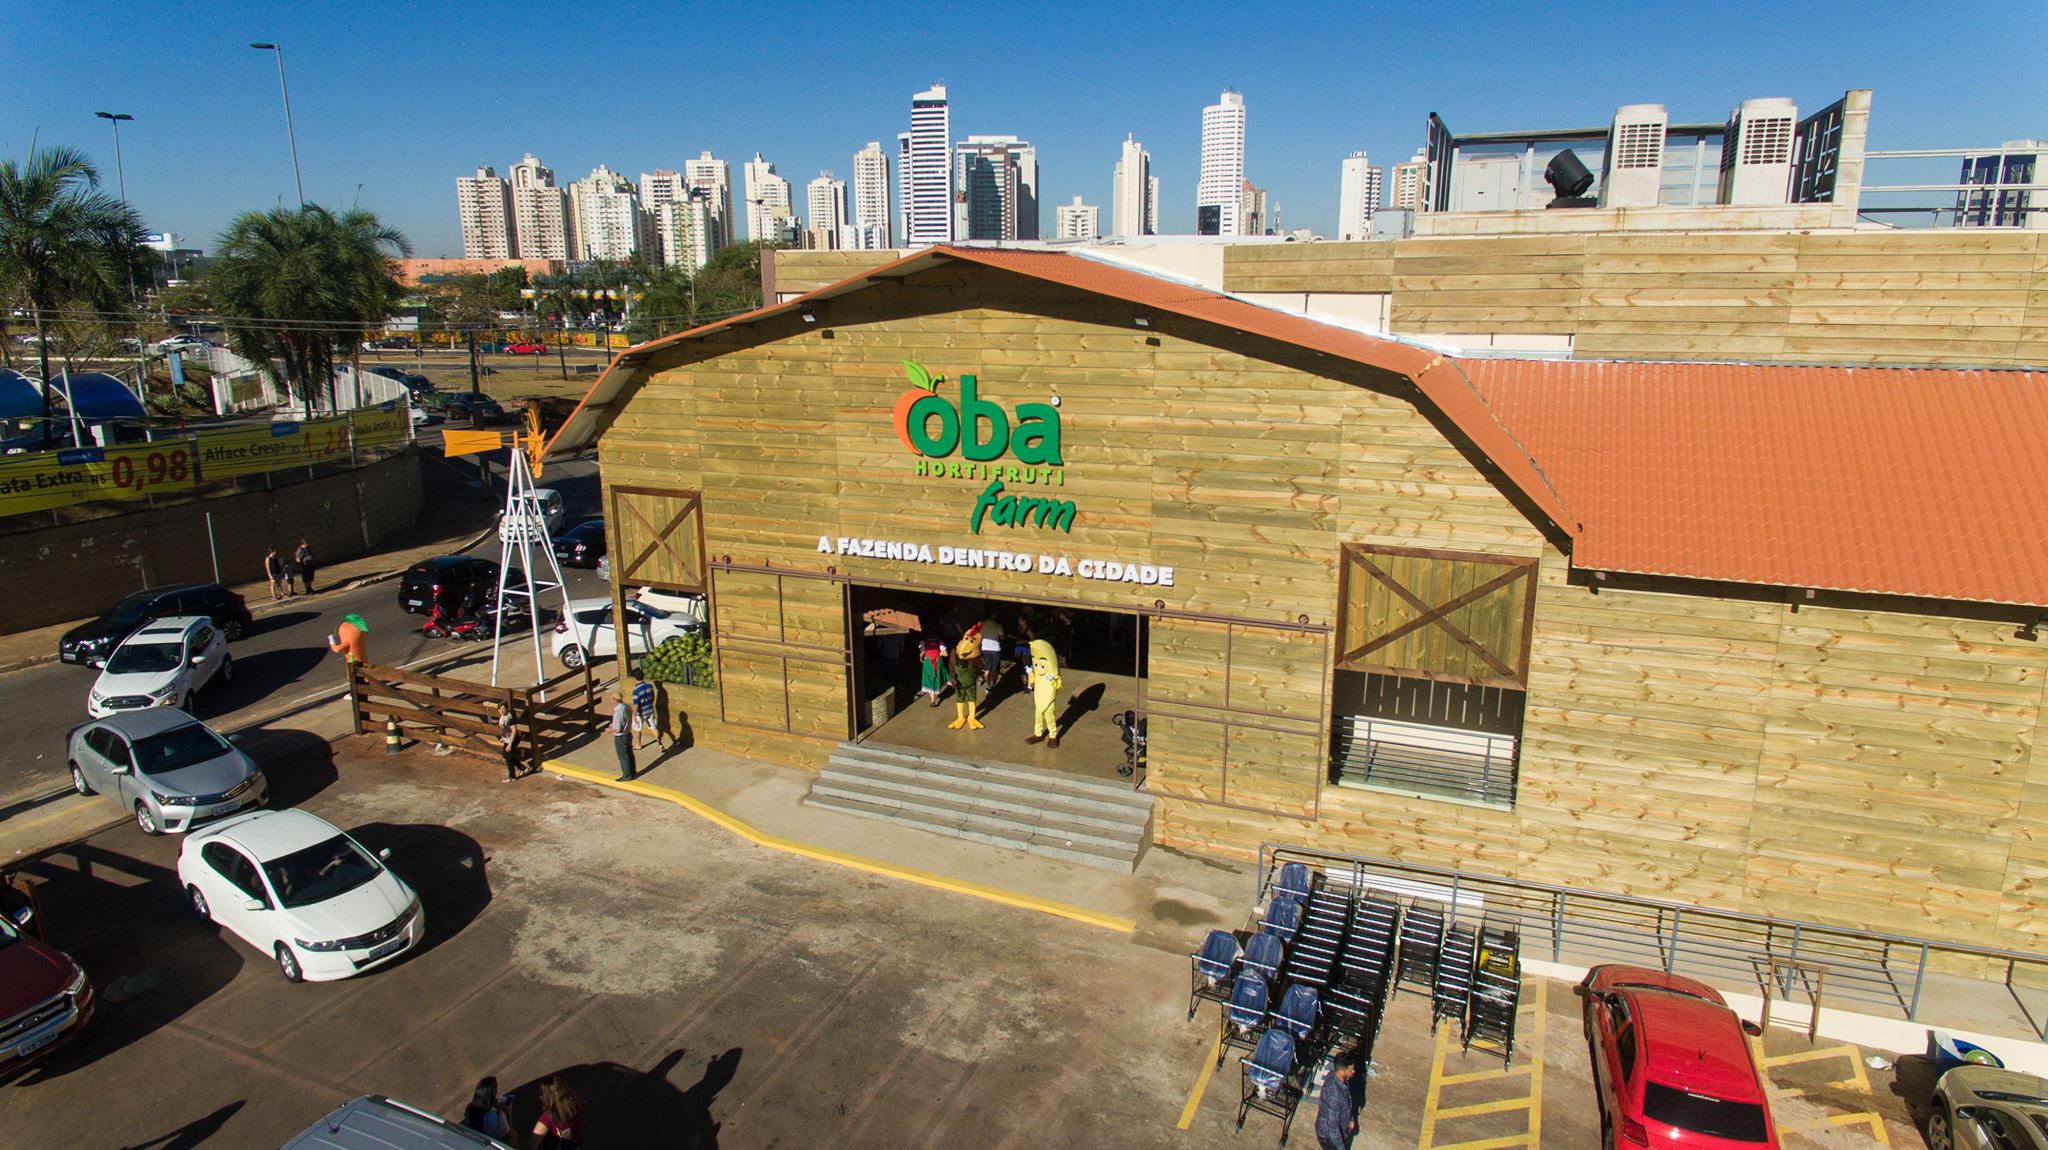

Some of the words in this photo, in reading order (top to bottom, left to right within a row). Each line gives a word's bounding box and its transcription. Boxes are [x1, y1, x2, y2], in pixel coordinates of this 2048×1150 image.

[907, 375, 1064, 466] oba
[36, 470, 82, 488] Extra
[91, 474, 106, 485] R$
[112, 449, 188, 491] 0,98
[205, 446, 247, 461] Alface
[915, 461, 1064, 486] HORTIFRUTI
[971, 480, 1077, 535] farm
[817, 535, 834, 554] A
[837, 537, 936, 564] FAZENDA
[938, 545, 1033, 573] DENTRO
[1039, 555, 1073, 577] DA
[1078, 559, 1174, 587] CIDADE
